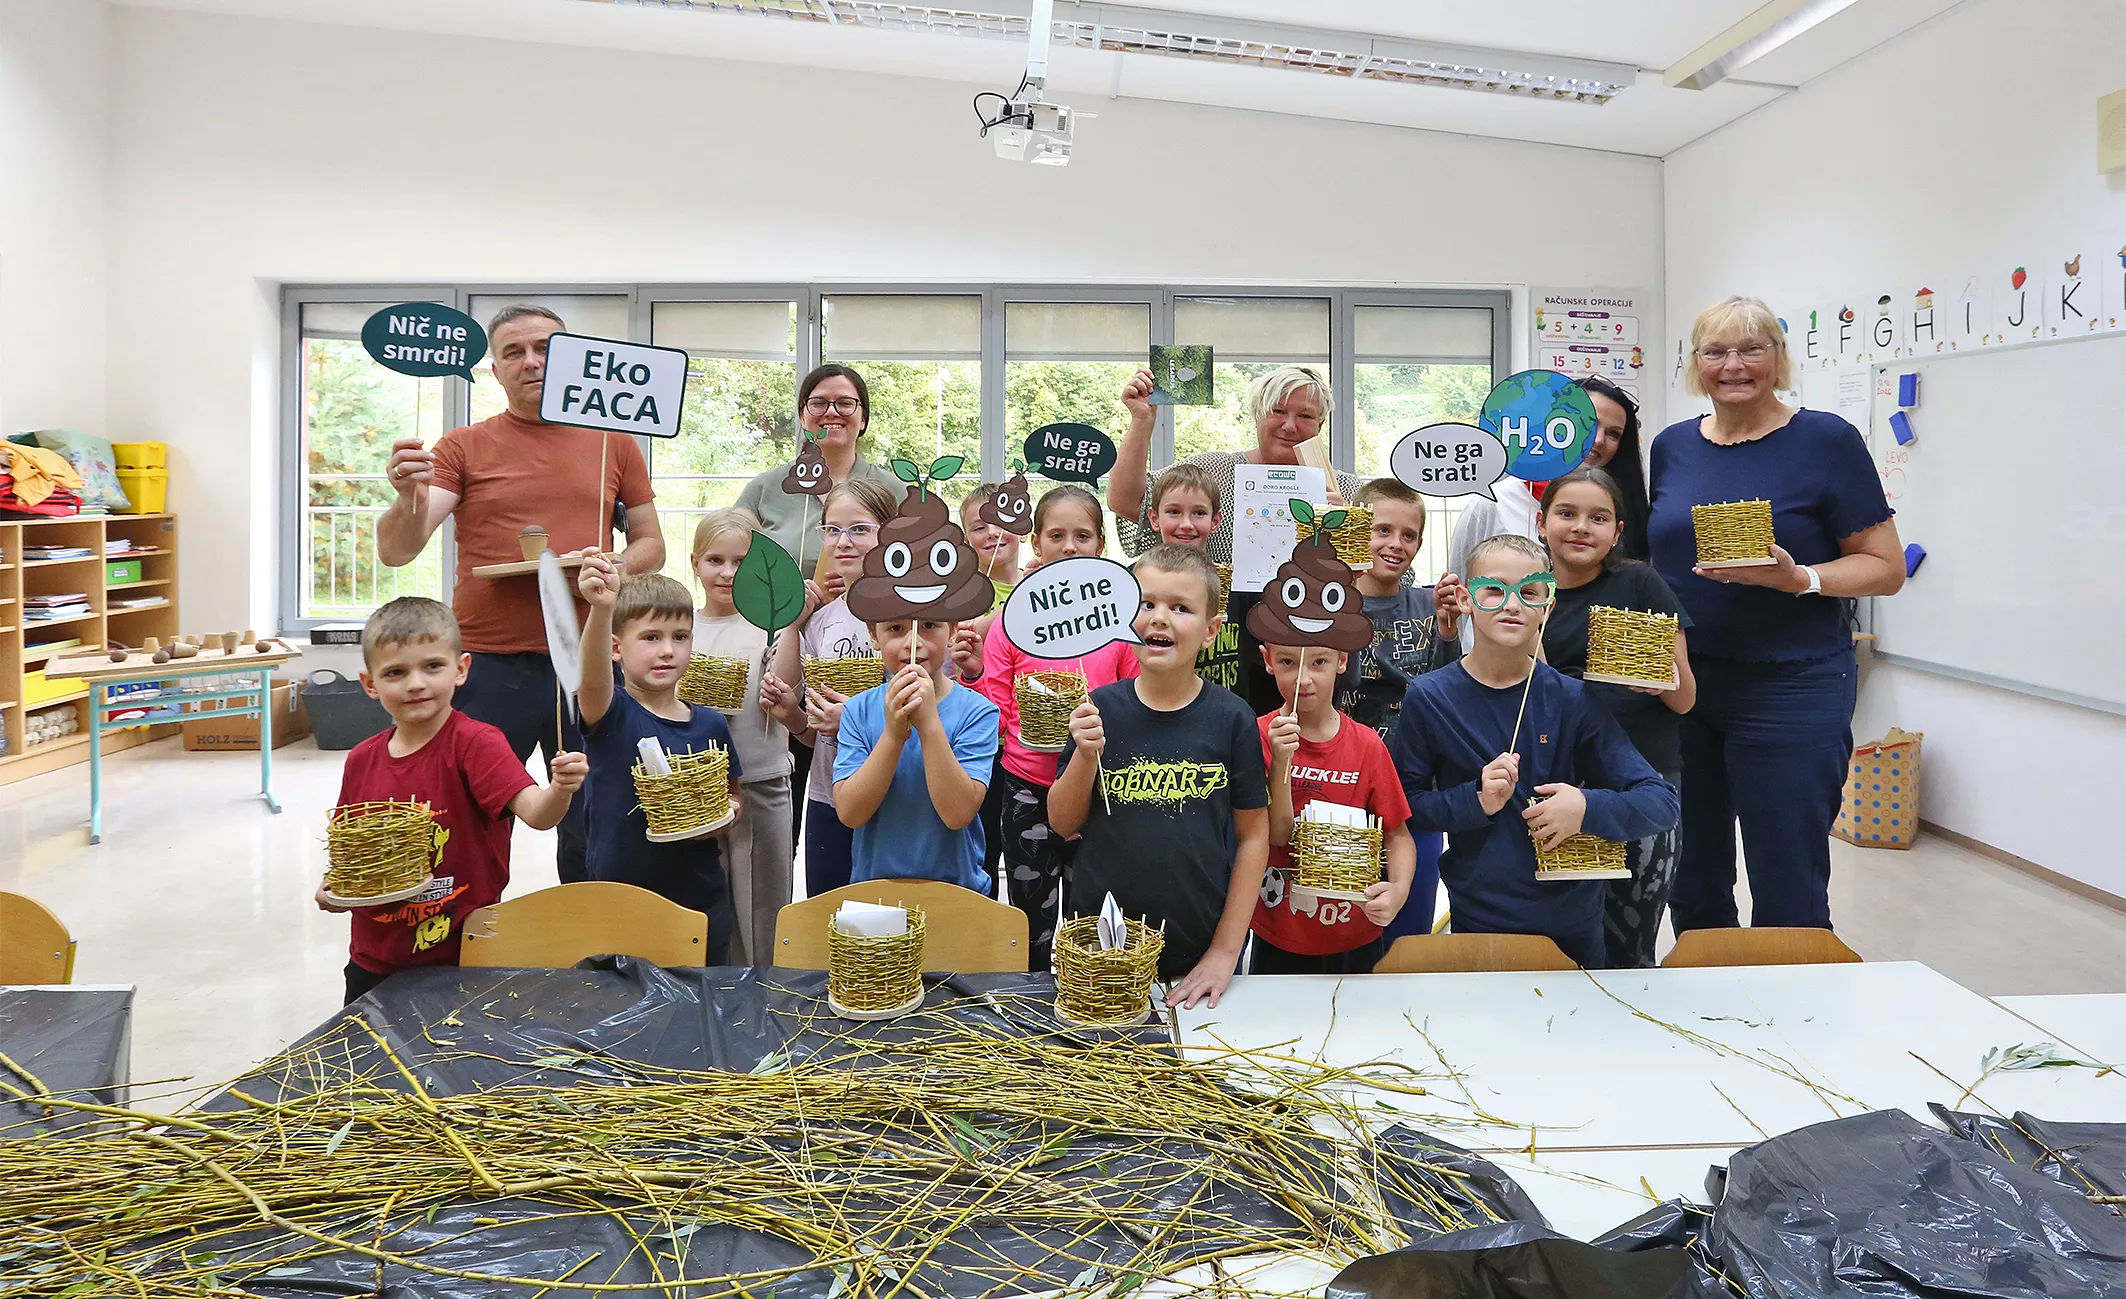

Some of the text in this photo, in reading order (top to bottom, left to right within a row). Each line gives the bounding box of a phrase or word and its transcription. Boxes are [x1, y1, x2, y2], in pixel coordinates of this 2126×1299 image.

[1544, 296, 1633, 308] RAČUNSKE OPERACIJE
[388, 313, 468, 342] Nič ne
[1555, 321, 1563, 332] 5
[1584, 322, 1593, 334] 4
[1615, 323, 1623, 334] 9
[1807, 329, 1819, 358] E
[1840, 323, 1852, 354] F
[1873, 317, 1893, 348] G
[1914, 308, 1934, 343] H
[2007, 291, 2026, 327] J
[2061, 281, 2083, 321] K
[383, 341, 466, 367] smrdi!
[1552, 356, 1565, 367] 15
[1584, 357, 1592, 369] 3
[1612, 358, 1625, 370] 12
[582, 349, 651, 387] Eko
[562, 384, 661, 425] FACA
[1043, 431, 1101, 458] Ne ga
[1414, 440, 1484, 464] Ne ga
[1044, 455, 1093, 474] srat!
[1421, 463, 1478, 482] srat!
[1028, 578, 1112, 614] Nič ne
[1033, 602, 1120, 645] smrdi!
[196, 735, 231, 745] HOLZ
[1290, 764, 1360, 785] UCKLES
[430, 888, 450, 900] STYLE
[431, 879, 450, 888] STYLE
